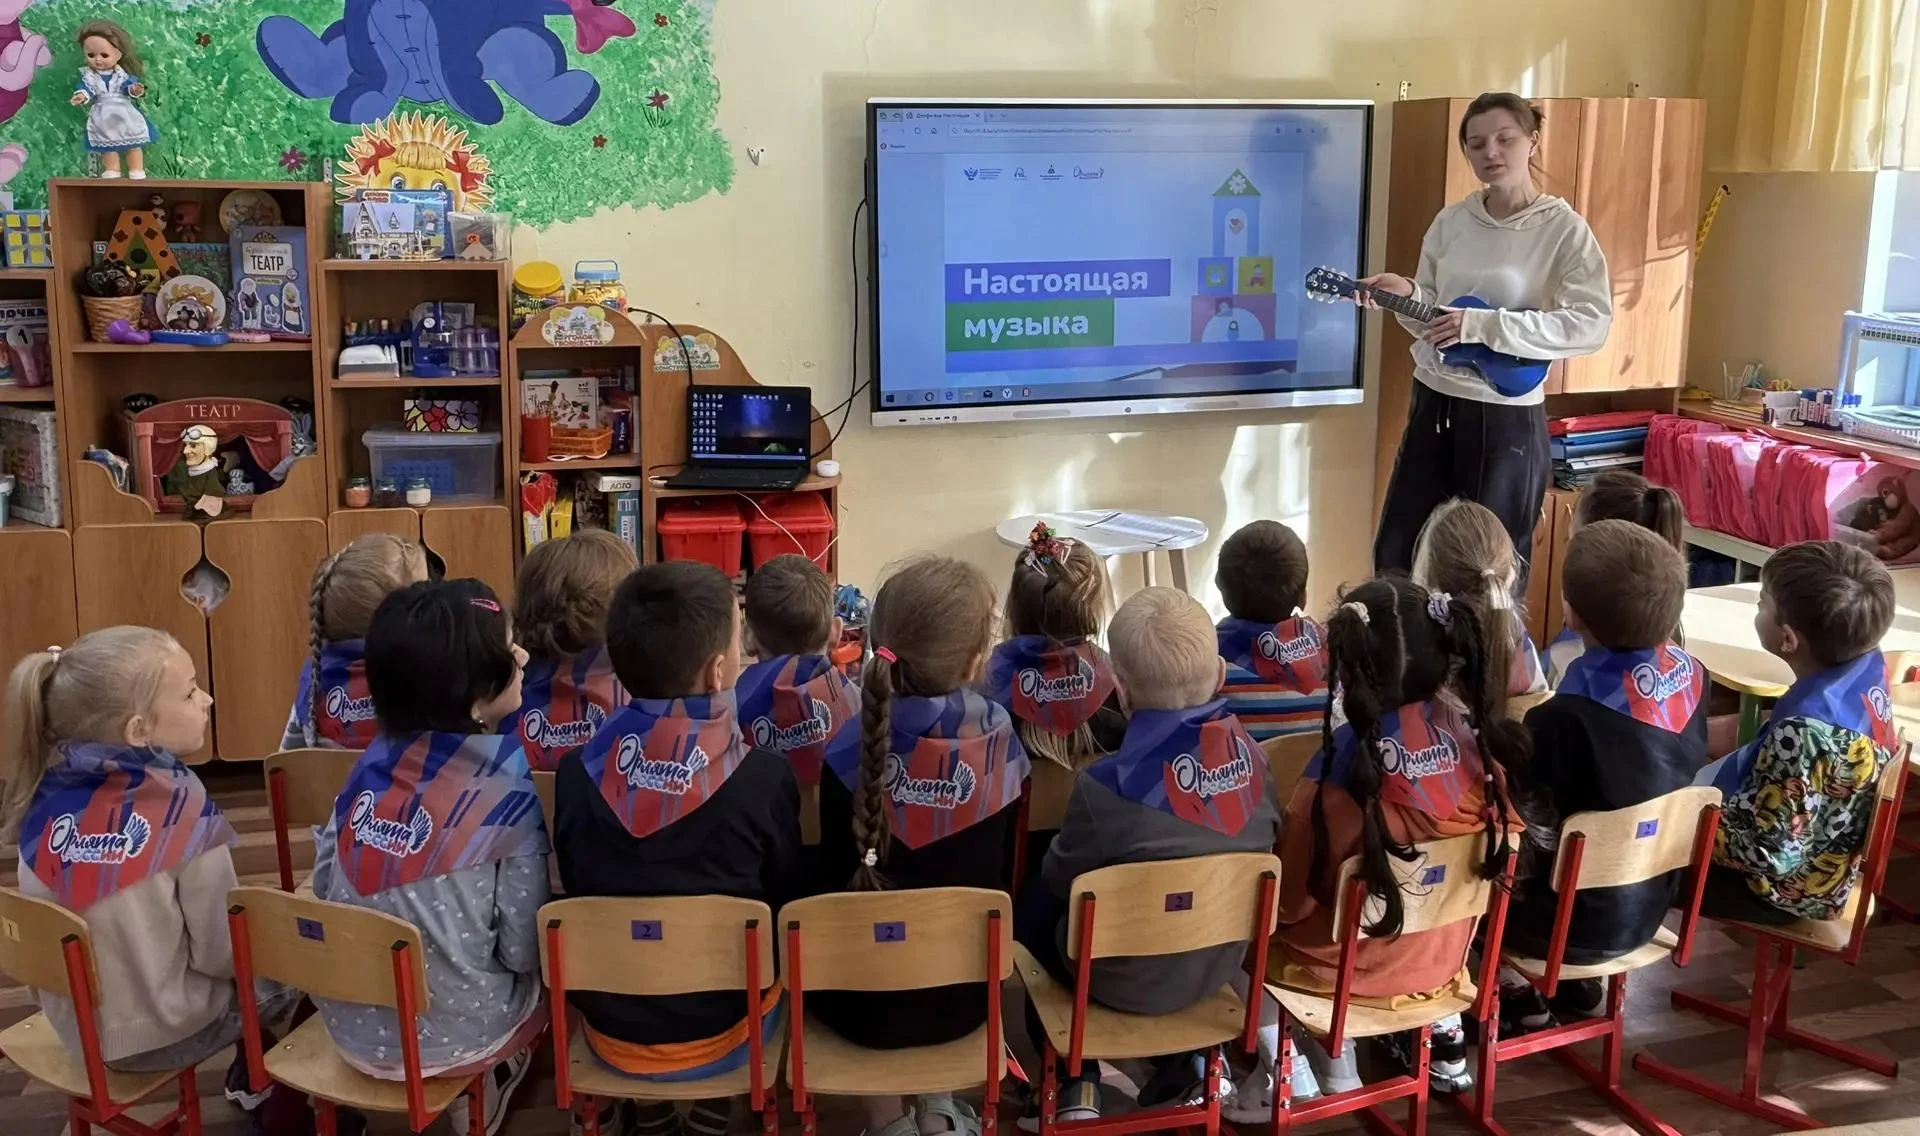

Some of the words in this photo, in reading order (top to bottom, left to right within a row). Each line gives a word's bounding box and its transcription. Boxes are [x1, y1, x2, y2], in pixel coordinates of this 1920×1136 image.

[250, 255, 284, 271] ТЕАТР
[964, 268, 1148, 295] Настоящая
[964, 315, 1089, 343] музыка
[185, 404, 241, 418] ТЕАТР
[1020, 668, 1085, 699] Орлята
[525, 710, 592, 744] Орлята
[753, 717, 821, 749] Орлята
[617, 735, 691, 780] Орлята
[1381, 738, 1449, 776] Орлята
[884, 754, 958, 796] Орлята
[1174, 755, 1247, 794] Орлята
[351, 791, 413, 843] Орлята
[50, 815, 129, 857] Орлята
